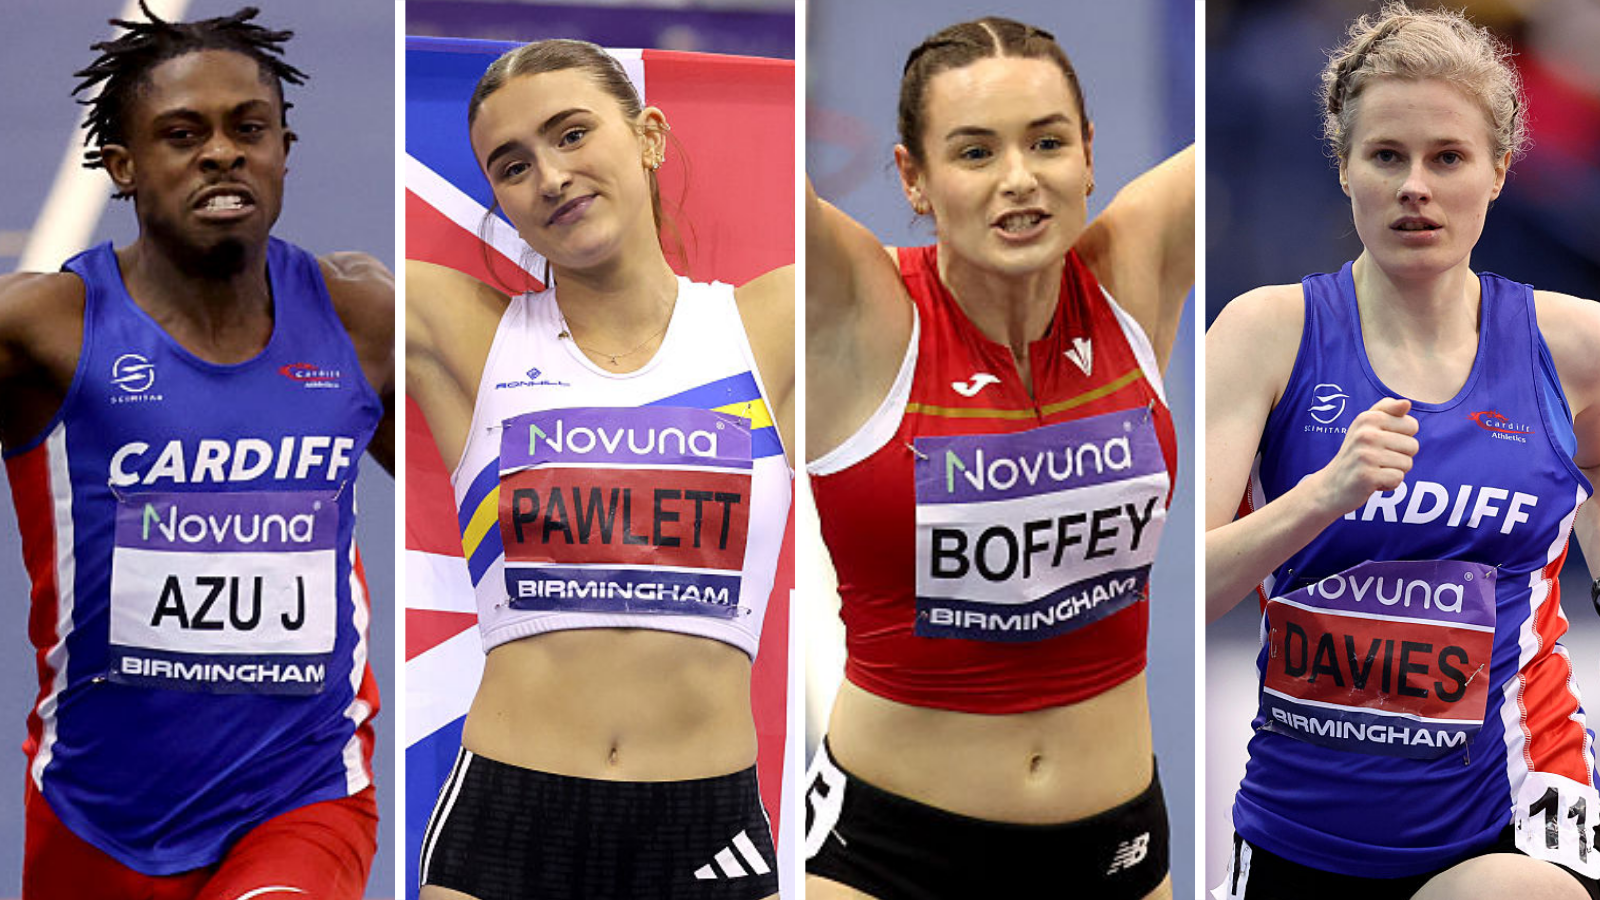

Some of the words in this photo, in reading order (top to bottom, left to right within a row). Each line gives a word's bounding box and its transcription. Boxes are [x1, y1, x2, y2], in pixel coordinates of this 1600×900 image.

[529, 419, 718, 457] Novuna
[1485, 419, 1530, 433] Cardiff
[1491, 432, 1527, 443] Athletics
[109, 436, 354, 486] CARDIFF
[946, 436, 1132, 493] Novuna
[142, 502, 314, 543] Novuna
[511, 486, 741, 550] PAWLETT
[930, 496, 1159, 581] BOFFEY
[150, 574, 263, 630] AZU
[281, 576, 306, 631] J
[518, 579, 730, 605] BIRMINGHAM
[930, 576, 1137, 631] BIRMINGHAM
[1306, 573, 1464, 613] ovuna
[121, 656, 326, 684] BIRMINGHAM
[1284, 621, 1470, 703] DAVIES
[1271, 707, 1467, 748] BIRMINGHAM
